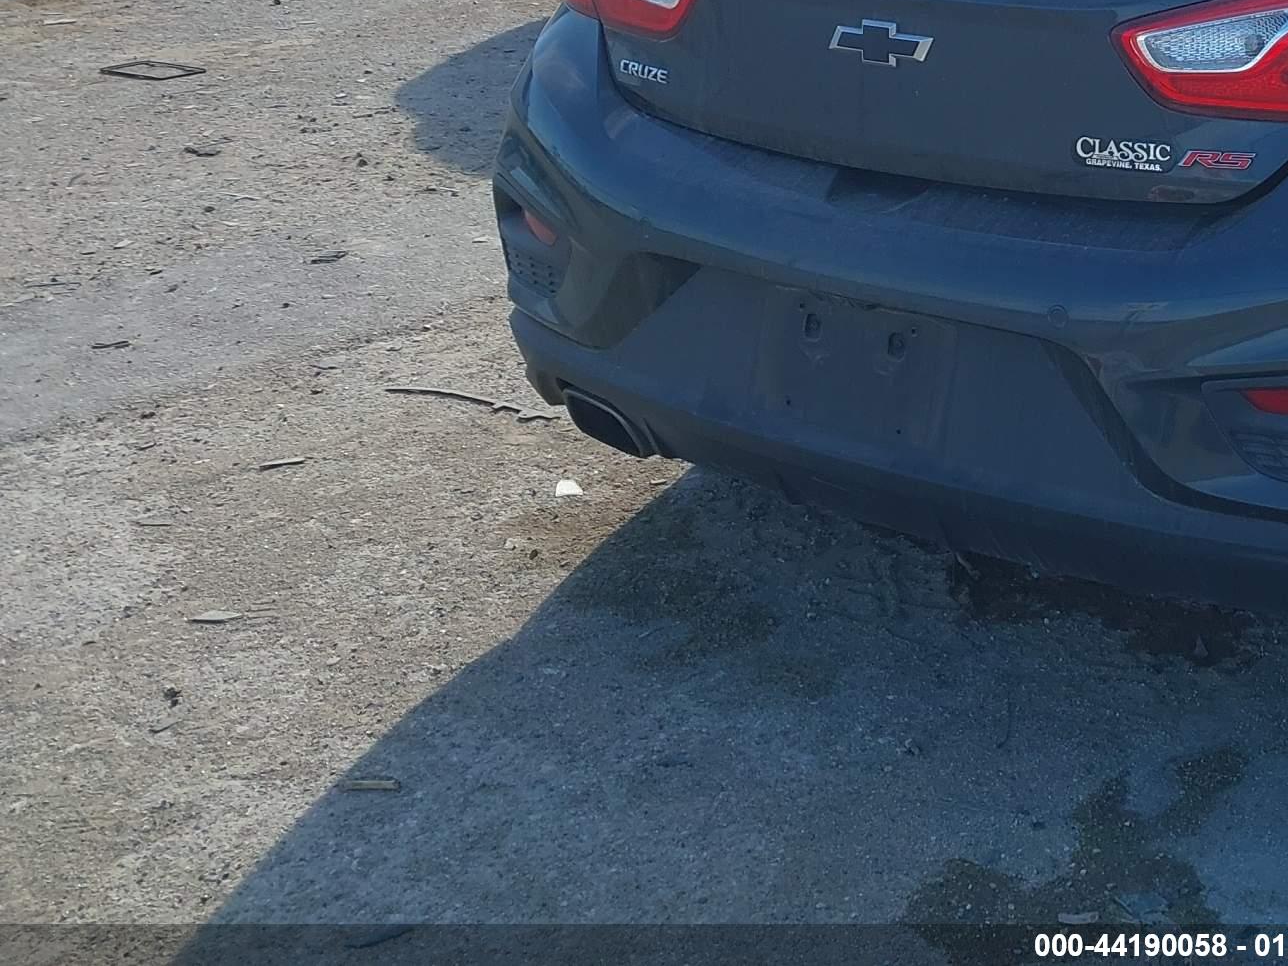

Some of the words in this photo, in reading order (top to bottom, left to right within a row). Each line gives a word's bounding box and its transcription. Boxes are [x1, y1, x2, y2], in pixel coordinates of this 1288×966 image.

[619, 59, 669, 84] CRUZE
[1075, 136, 1171, 162] CLASSIC
[1178, 150, 1257, 171] RS
